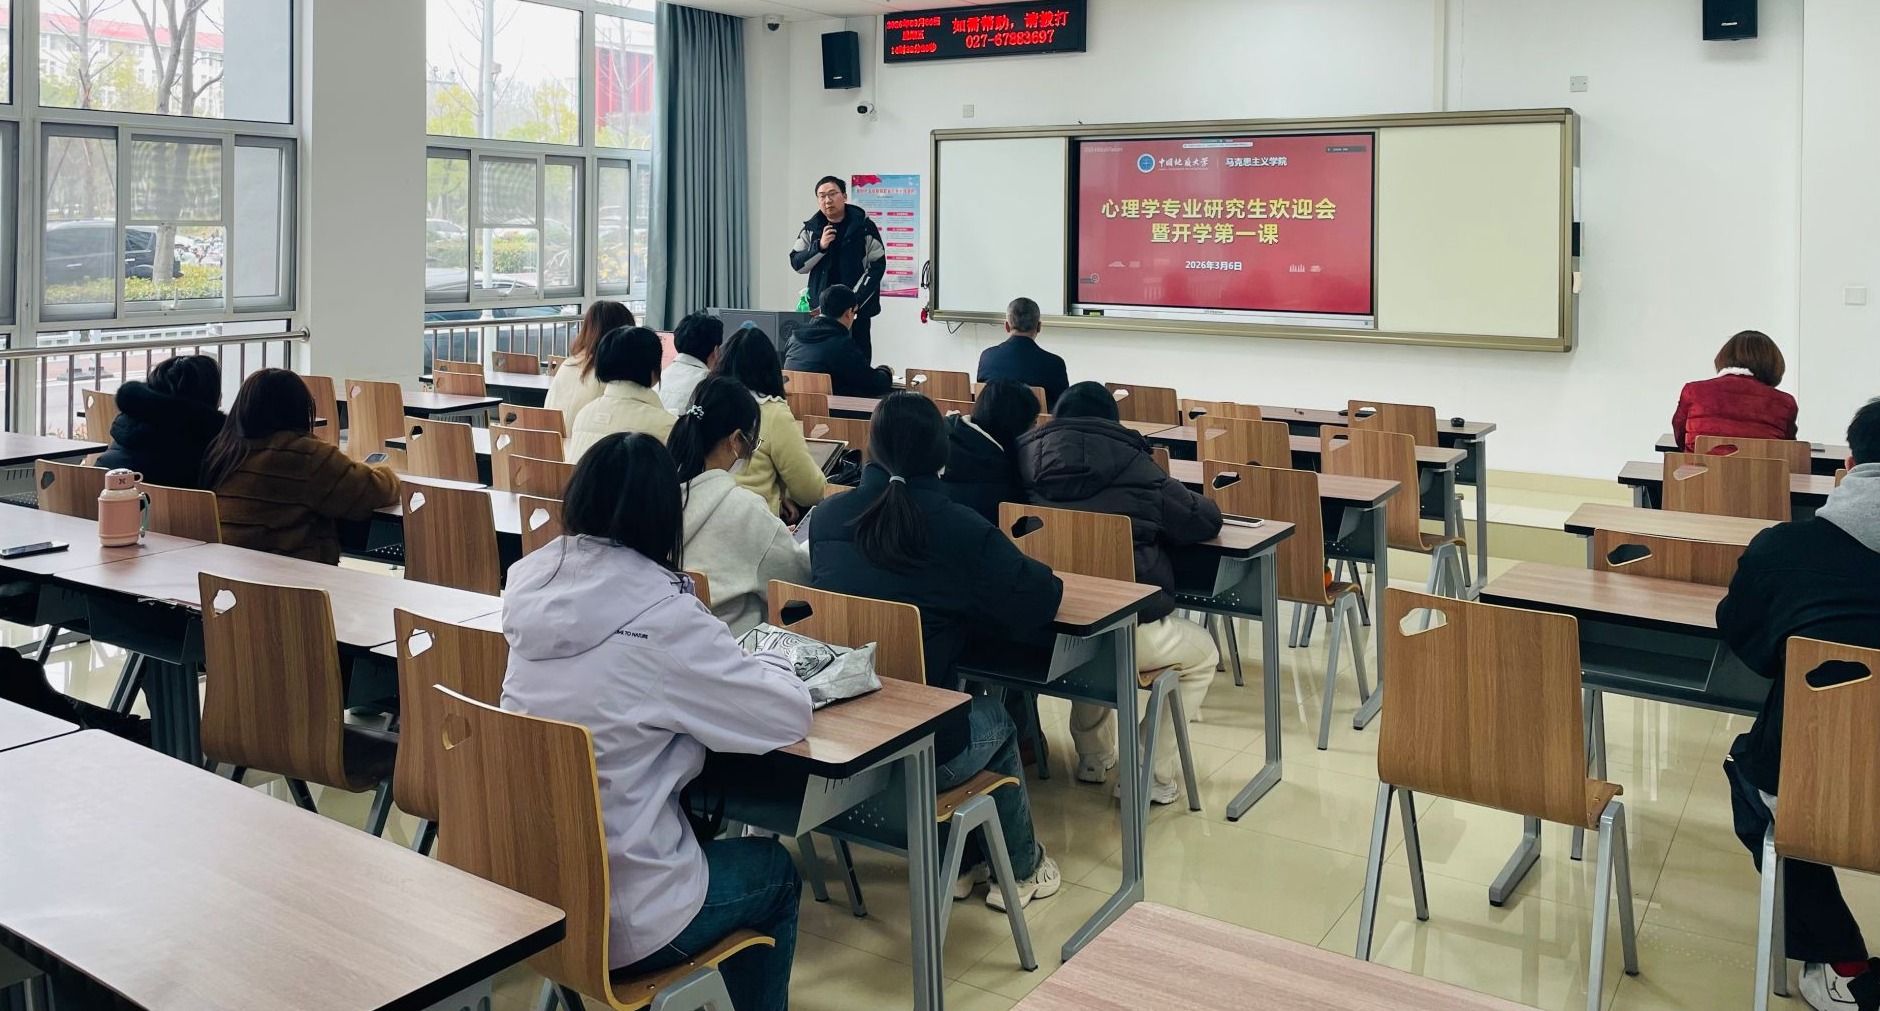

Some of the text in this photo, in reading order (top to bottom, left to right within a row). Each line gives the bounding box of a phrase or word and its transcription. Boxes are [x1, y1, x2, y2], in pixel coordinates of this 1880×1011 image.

[1225, 156, 1288, 168] 马克思主义学院
[1101, 198, 1337, 219] 心理学专业研究生欢迎会
[1151, 223, 1279, 244] 暨开学第一课
[1185, 260, 1243, 271] 2026年3月6日
